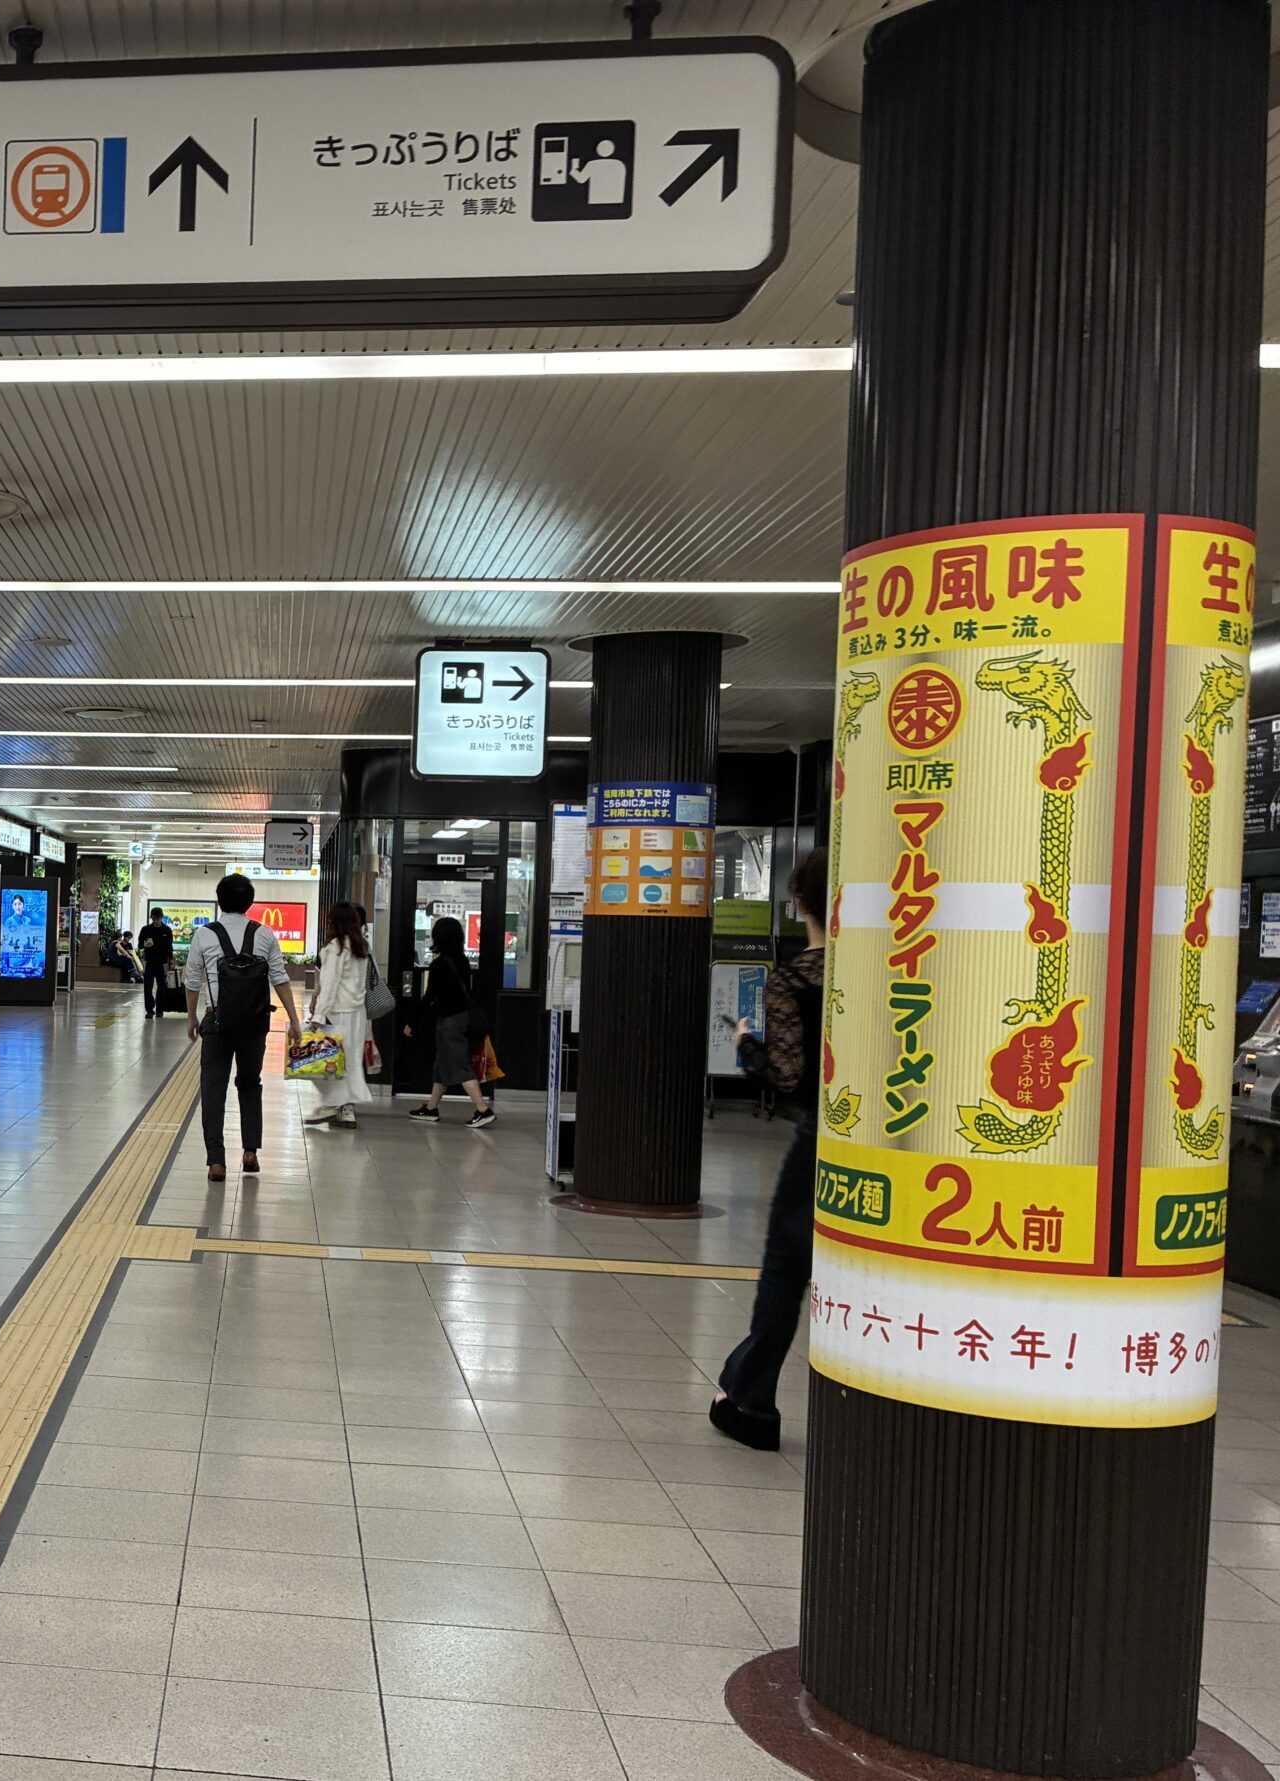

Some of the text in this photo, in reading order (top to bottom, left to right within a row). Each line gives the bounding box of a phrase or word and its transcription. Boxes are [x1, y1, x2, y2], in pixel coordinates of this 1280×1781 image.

[313, 128, 522, 168] きっぷうりば
[443, 173, 517, 192] Tickets
[372, 199, 445, 218] 표사는곳
[462, 197, 516, 216] 售票处
[841, 538, 1084, 634] 生の風味
[446, 714, 535, 730] きっぷうりば
[504, 732, 534, 741] Tickets
[886, 761, 954, 792] 即席
[603, 799, 670, 808] こちらのICカードが
[1017, 1033, 1035, 1105] しょうゆ味
[1039, 1034, 1055, 1089] あっさり
[921, 1162, 1064, 1254] 2人前
